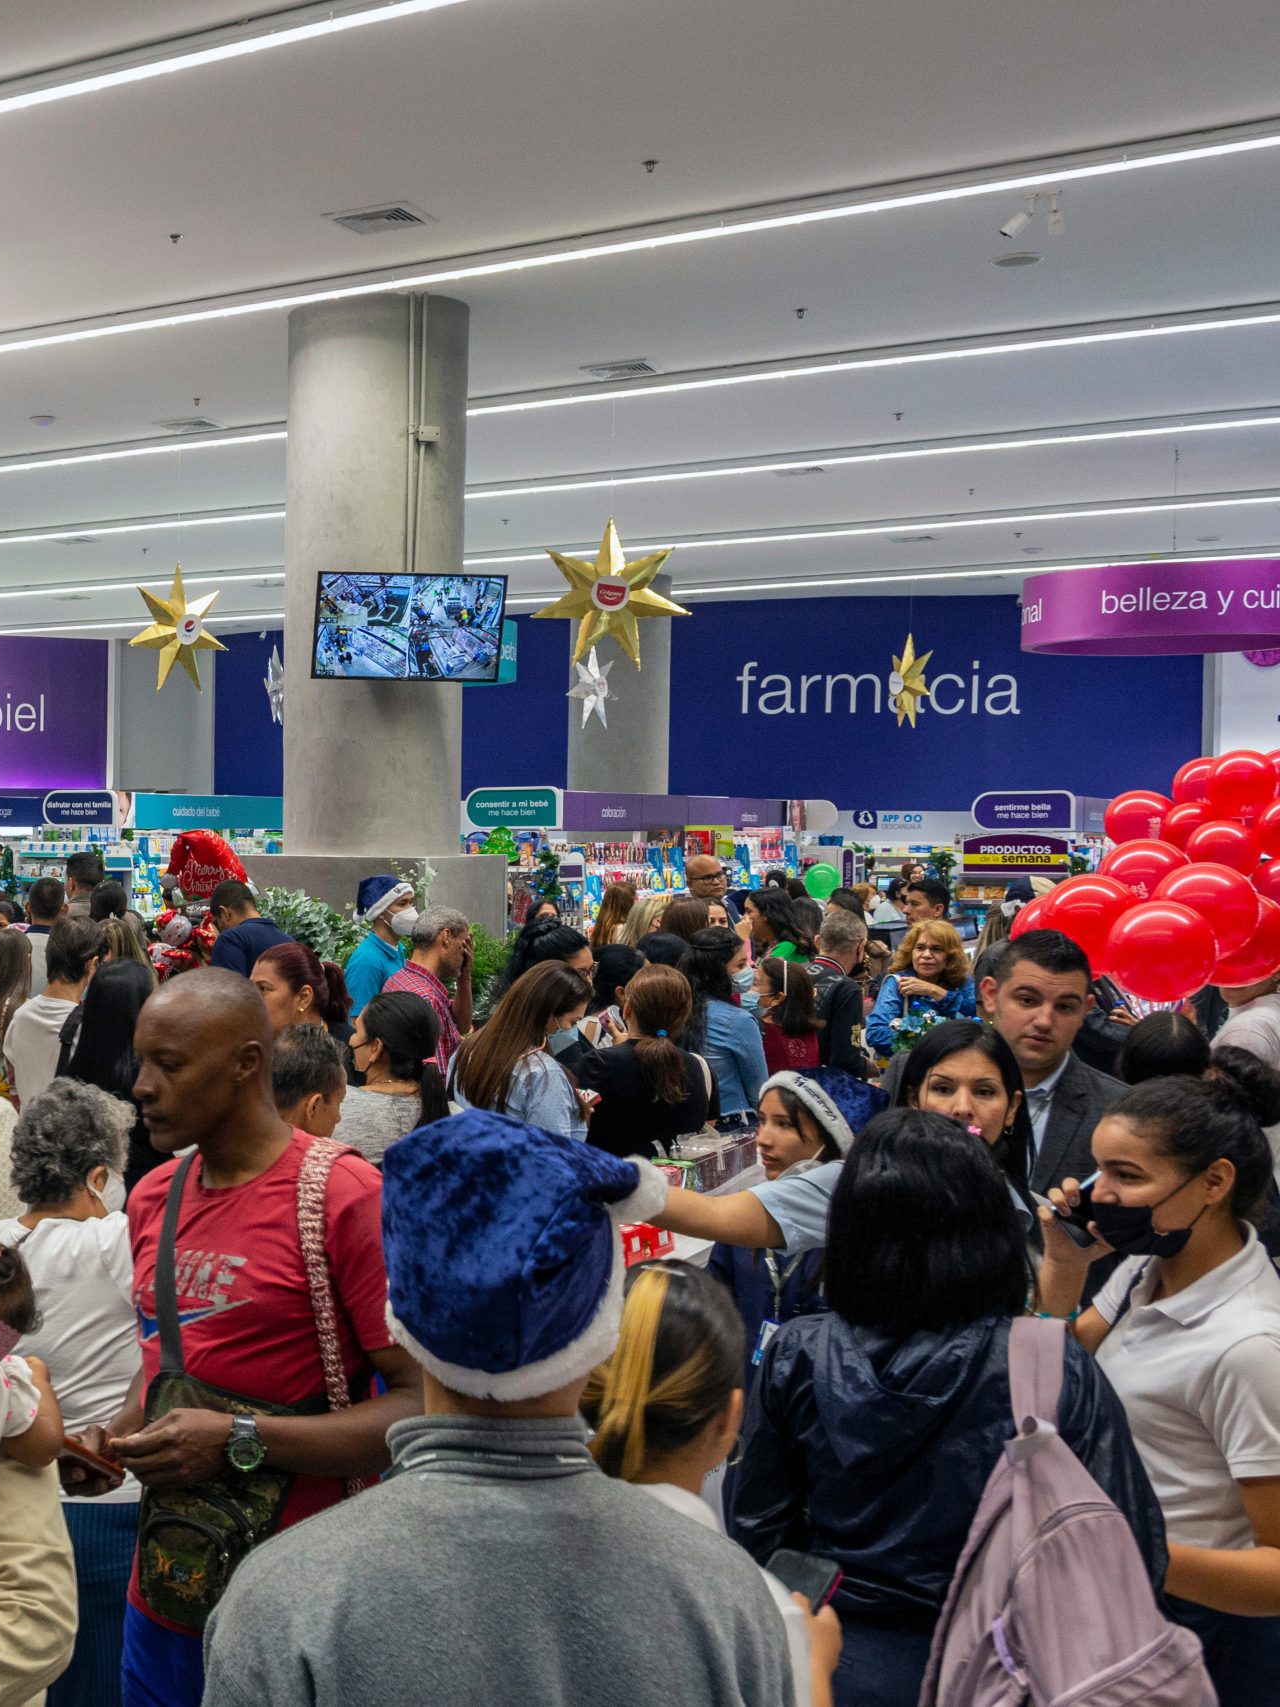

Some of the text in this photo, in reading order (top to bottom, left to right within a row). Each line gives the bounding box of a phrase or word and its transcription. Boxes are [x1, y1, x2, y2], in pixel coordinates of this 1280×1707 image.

[1101, 586, 1207, 614] belleza
[1217, 590, 1234, 615] y
[47, 801, 71, 809] disfrutar
[530, 799, 549, 807] bebé
[173, 806, 195, 817] cuidado
[197, 806, 205, 817] del
[520, 808, 536, 816] bien
[1011, 811, 1030, 819] hace
[1032, 811, 1049, 819] bien
[980, 845, 1052, 854] PRODUCTOS
[1001, 855, 1051, 863] semana
[184, 858, 225, 880] Merry
